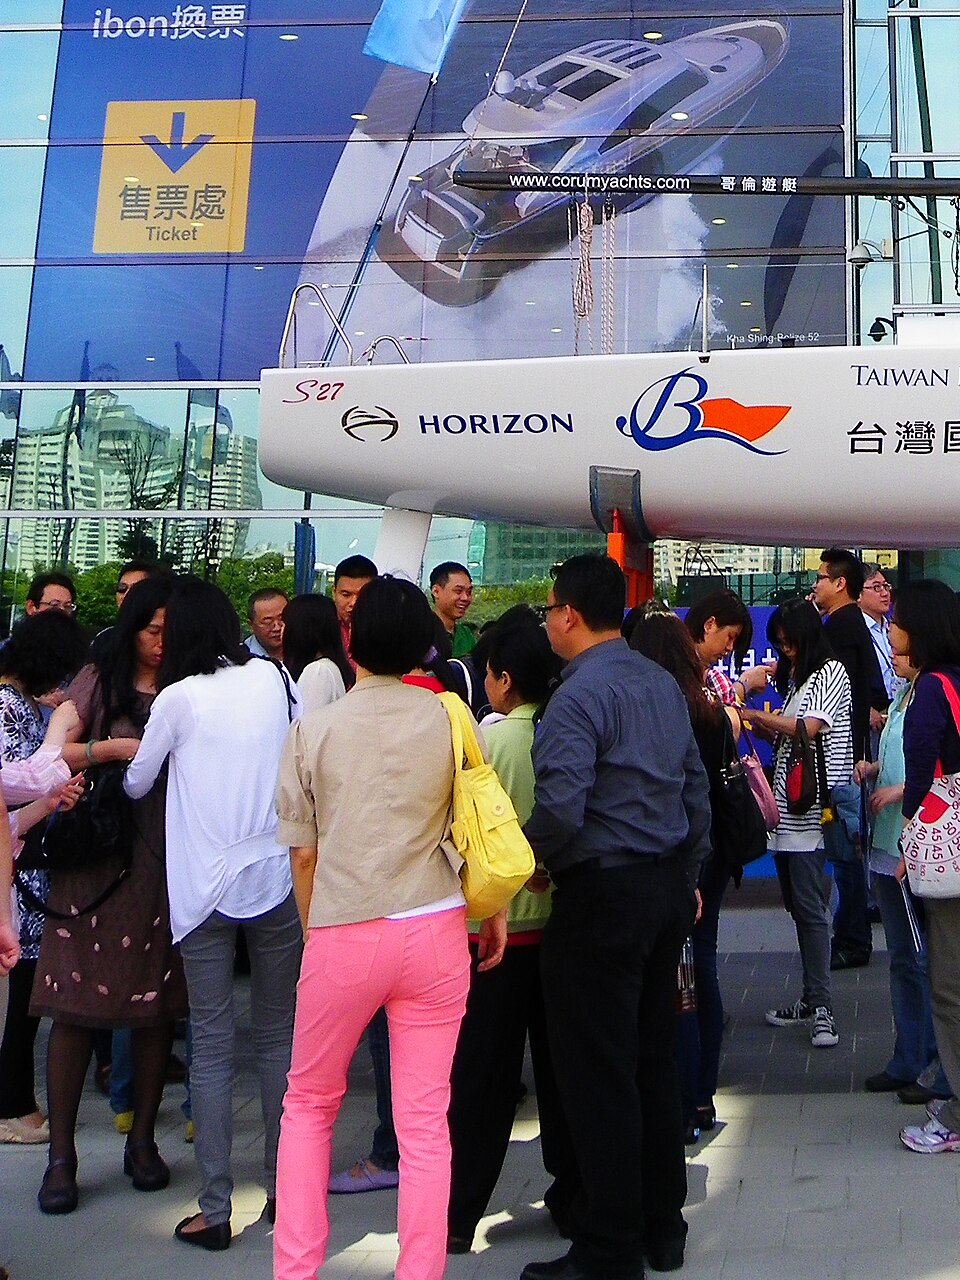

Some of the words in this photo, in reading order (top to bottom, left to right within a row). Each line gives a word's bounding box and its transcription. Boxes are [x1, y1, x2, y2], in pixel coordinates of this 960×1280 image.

[92, 3, 247, 40] ibon換票
[508, 173, 691, 192] www.corumyachts.com
[720, 175, 799, 193] 哥倫遊艇
[119, 183, 227, 221] 售票處
[145, 226, 198, 241] Ticket
[807, 332, 820, 341] 52
[850, 364, 949, 387] TAIWAN
[419, 413, 574, 436] HORIZON
